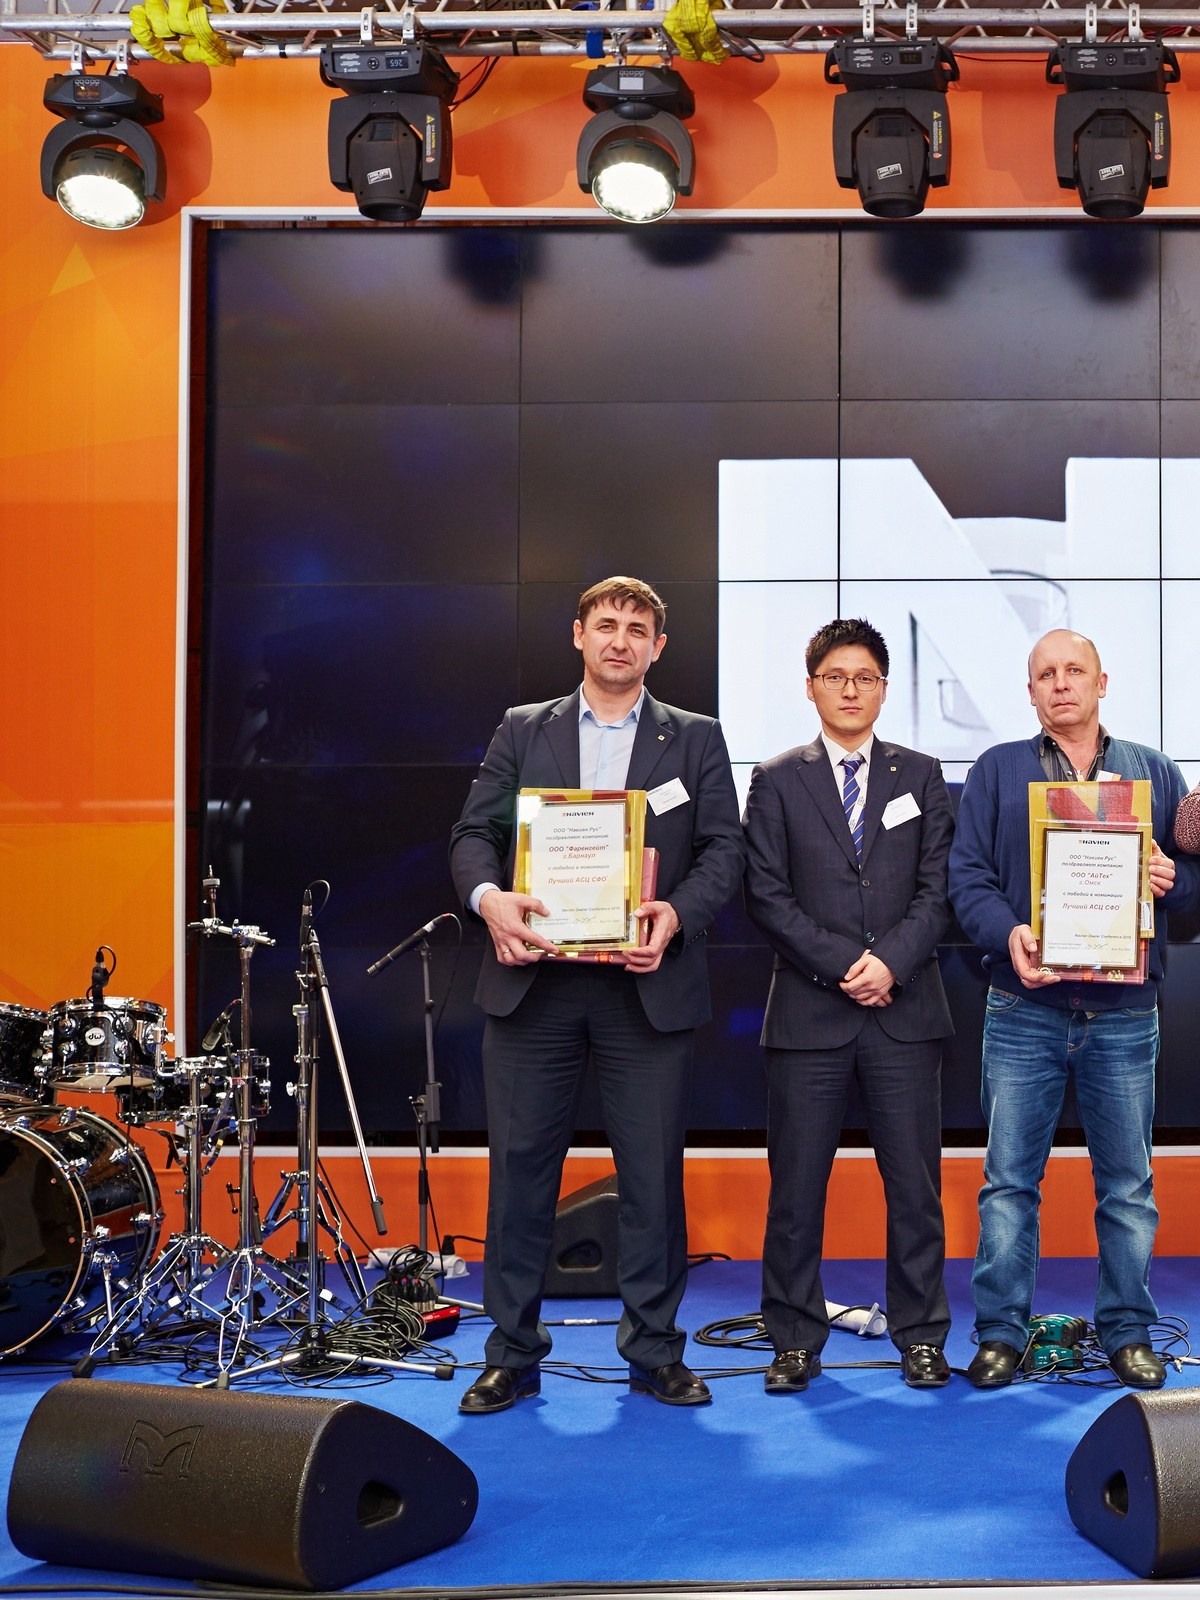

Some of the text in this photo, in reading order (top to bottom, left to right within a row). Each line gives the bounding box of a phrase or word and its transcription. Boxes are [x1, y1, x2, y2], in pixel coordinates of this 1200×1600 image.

[389, 59, 403, 67] 265
[548, 877, 574, 885] Лучший
[1062, 902, 1088, 910] Лучший
[1089, 903, 1104, 911] АСЦ
